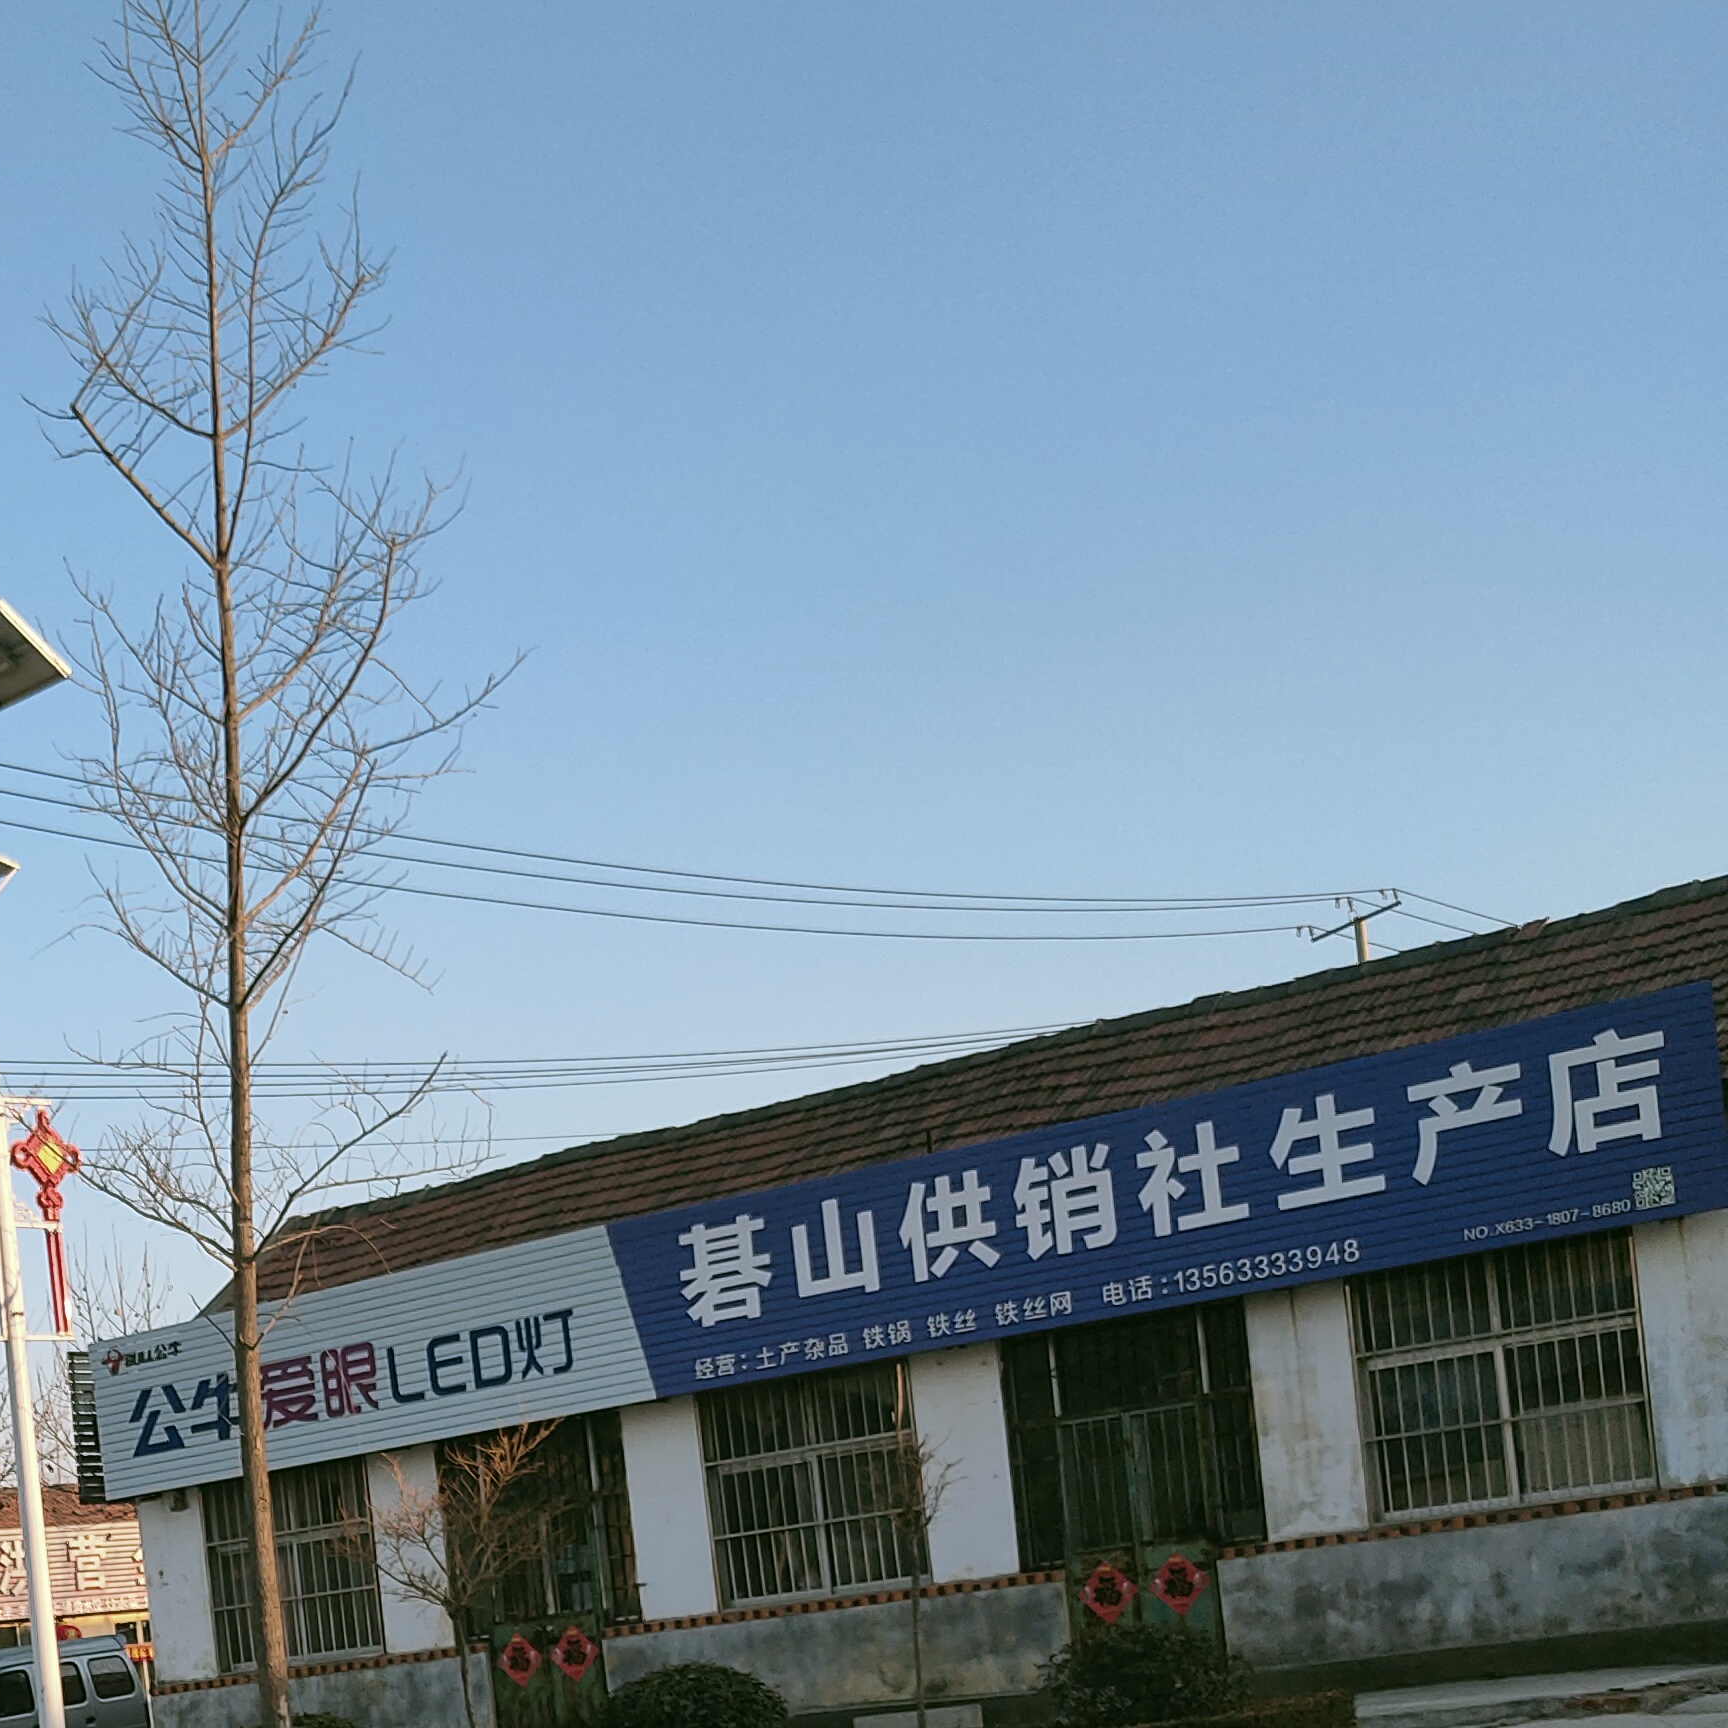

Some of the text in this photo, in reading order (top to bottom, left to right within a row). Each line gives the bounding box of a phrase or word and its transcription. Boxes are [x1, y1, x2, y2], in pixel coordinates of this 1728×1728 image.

[678, 1029, 1664, 1327] 碁山供销社生产店
[863, 1320, 911, 1350] 铁锅
[926, 1308, 976, 1338] 铁丝
[994, 1291, 1072, 1327] 铁丝网
